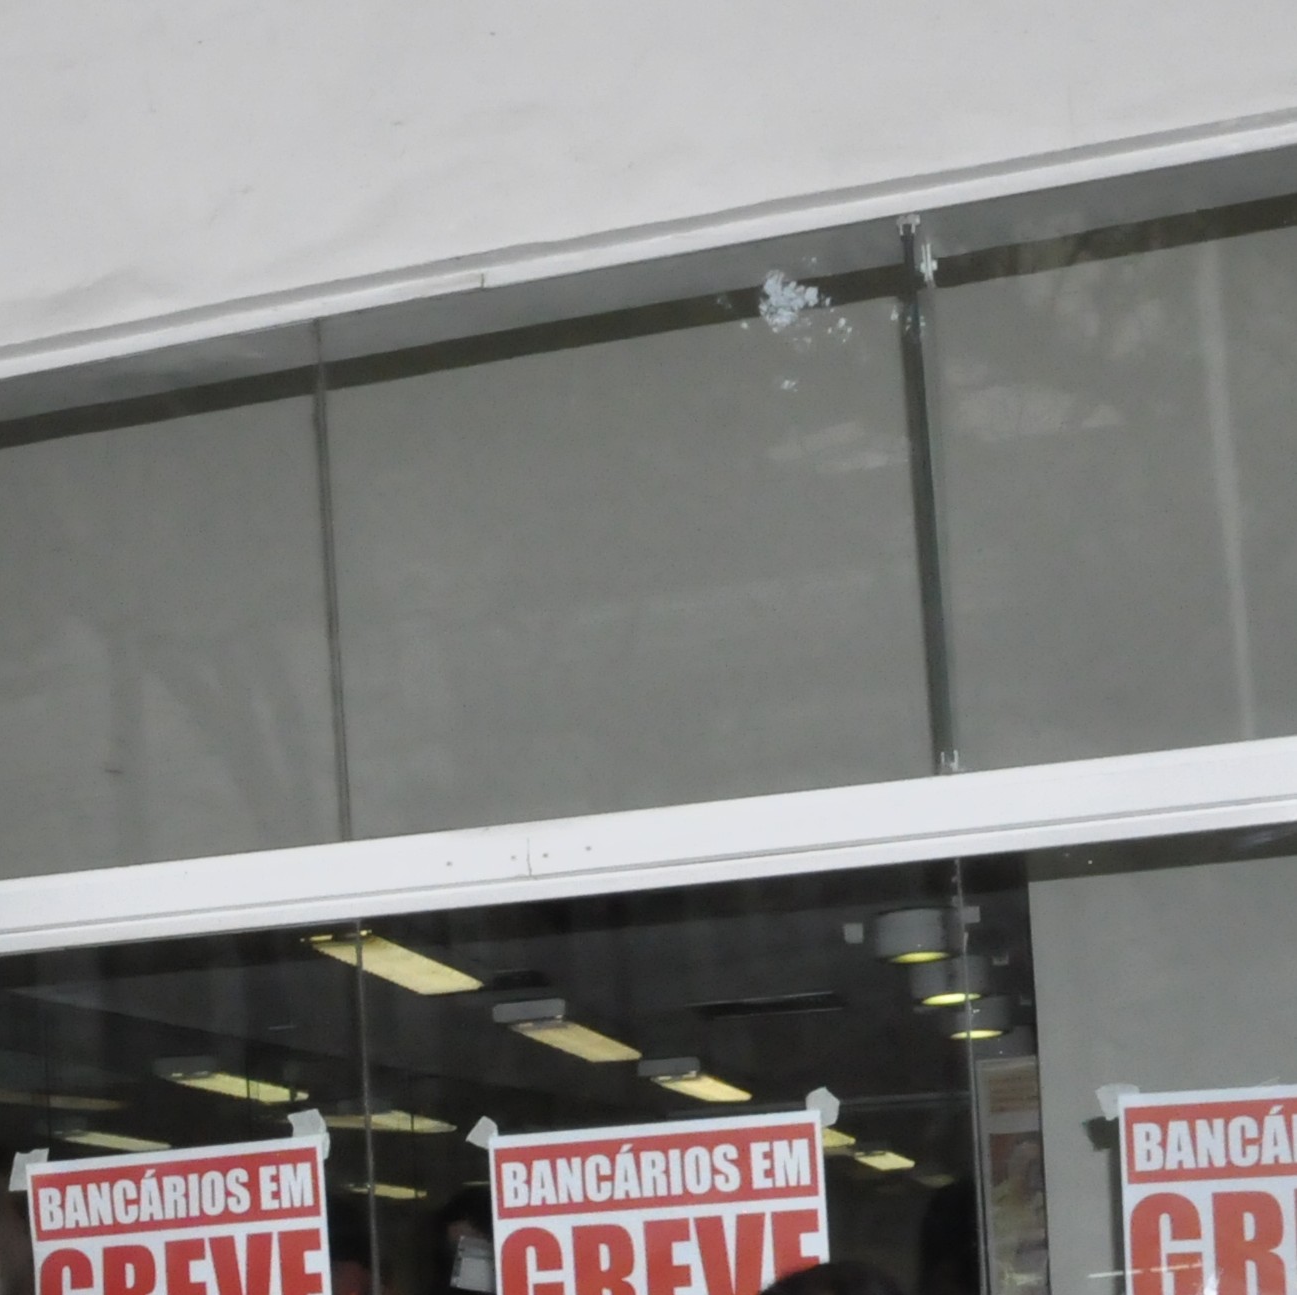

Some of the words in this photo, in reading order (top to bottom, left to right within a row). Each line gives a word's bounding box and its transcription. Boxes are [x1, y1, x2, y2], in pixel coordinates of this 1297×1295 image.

[1133, 1105, 1297, 1172] BANCÁ
[38, 1169, 251, 1231] BANCÁRIOS
[259, 1162, 314, 1211] EM
[501, 1144, 741, 1209] BANCÁRIOS
[750, 1138, 812, 1190] EM
